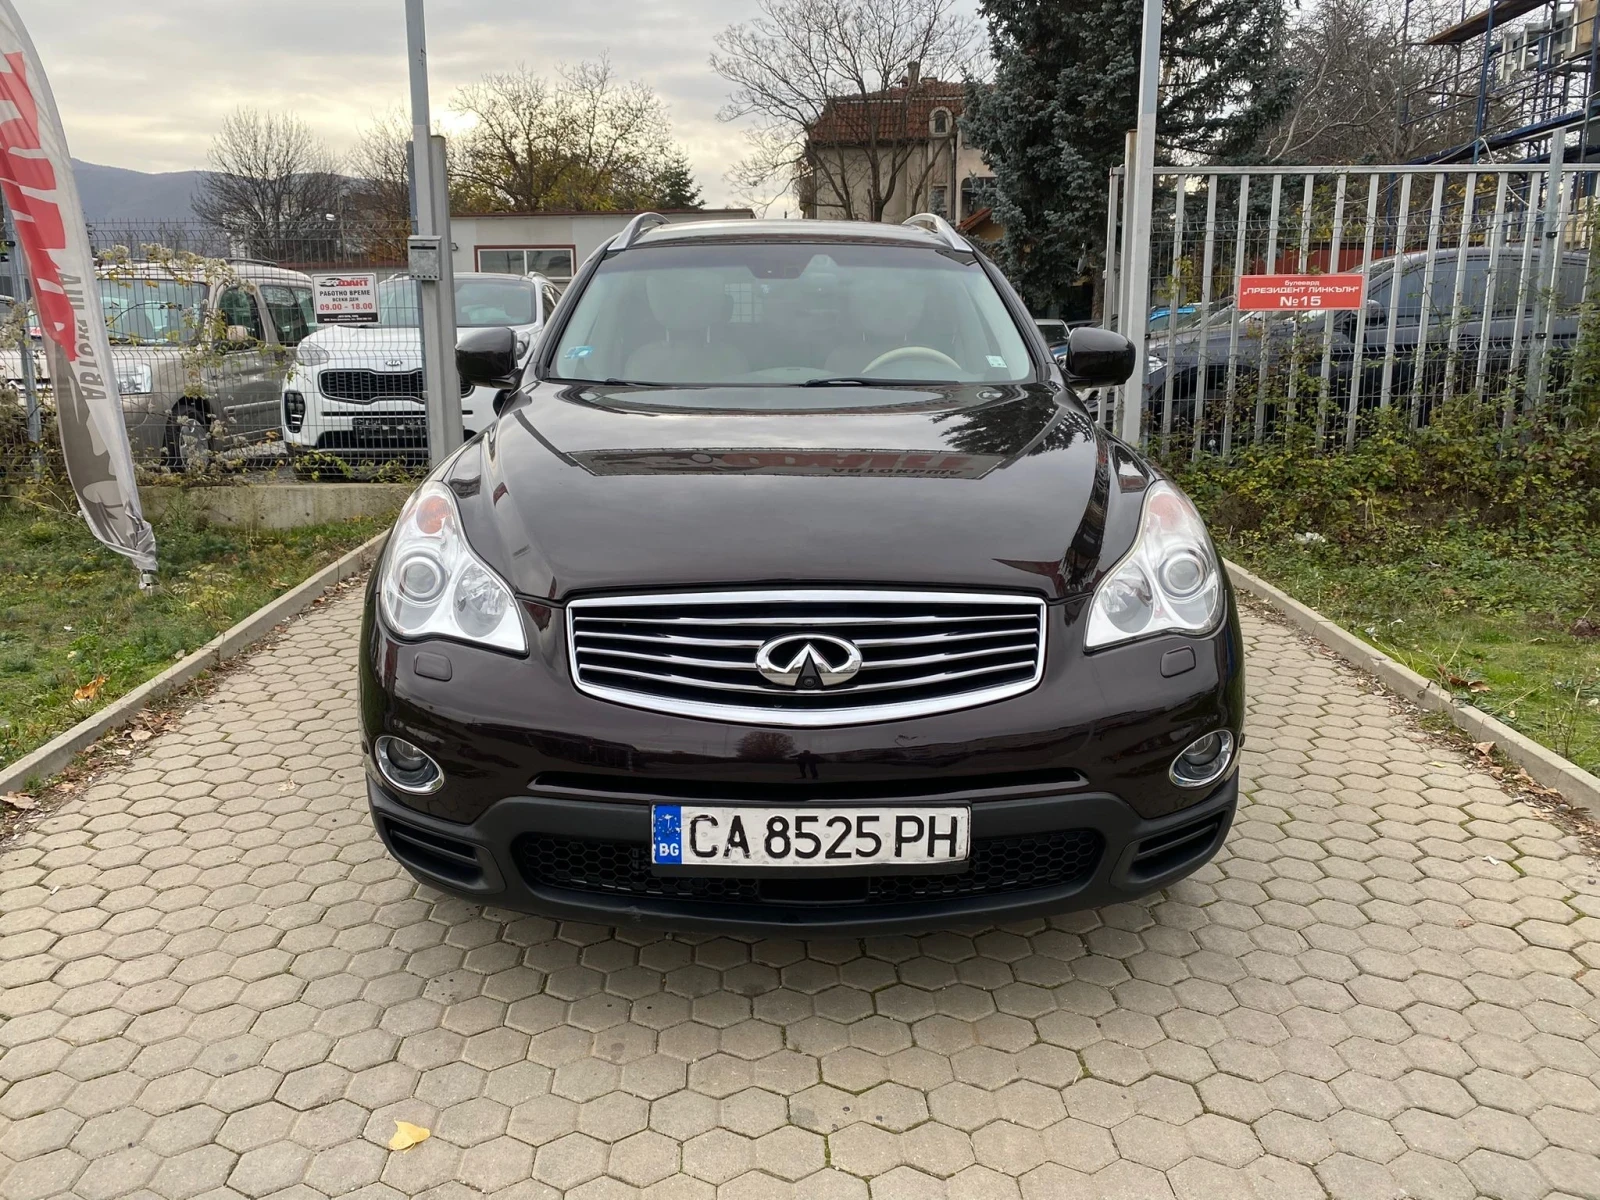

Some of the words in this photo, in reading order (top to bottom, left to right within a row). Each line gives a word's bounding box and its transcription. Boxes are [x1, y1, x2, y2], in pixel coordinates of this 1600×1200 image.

[320, 303, 342, 311] 09.00
[351, 302, 373, 310] 18.00
[659, 842, 680, 857] BG
[689, 814, 750, 859] CA
[763, 814, 882, 859] 8525
[894, 814, 958, 858] PH
